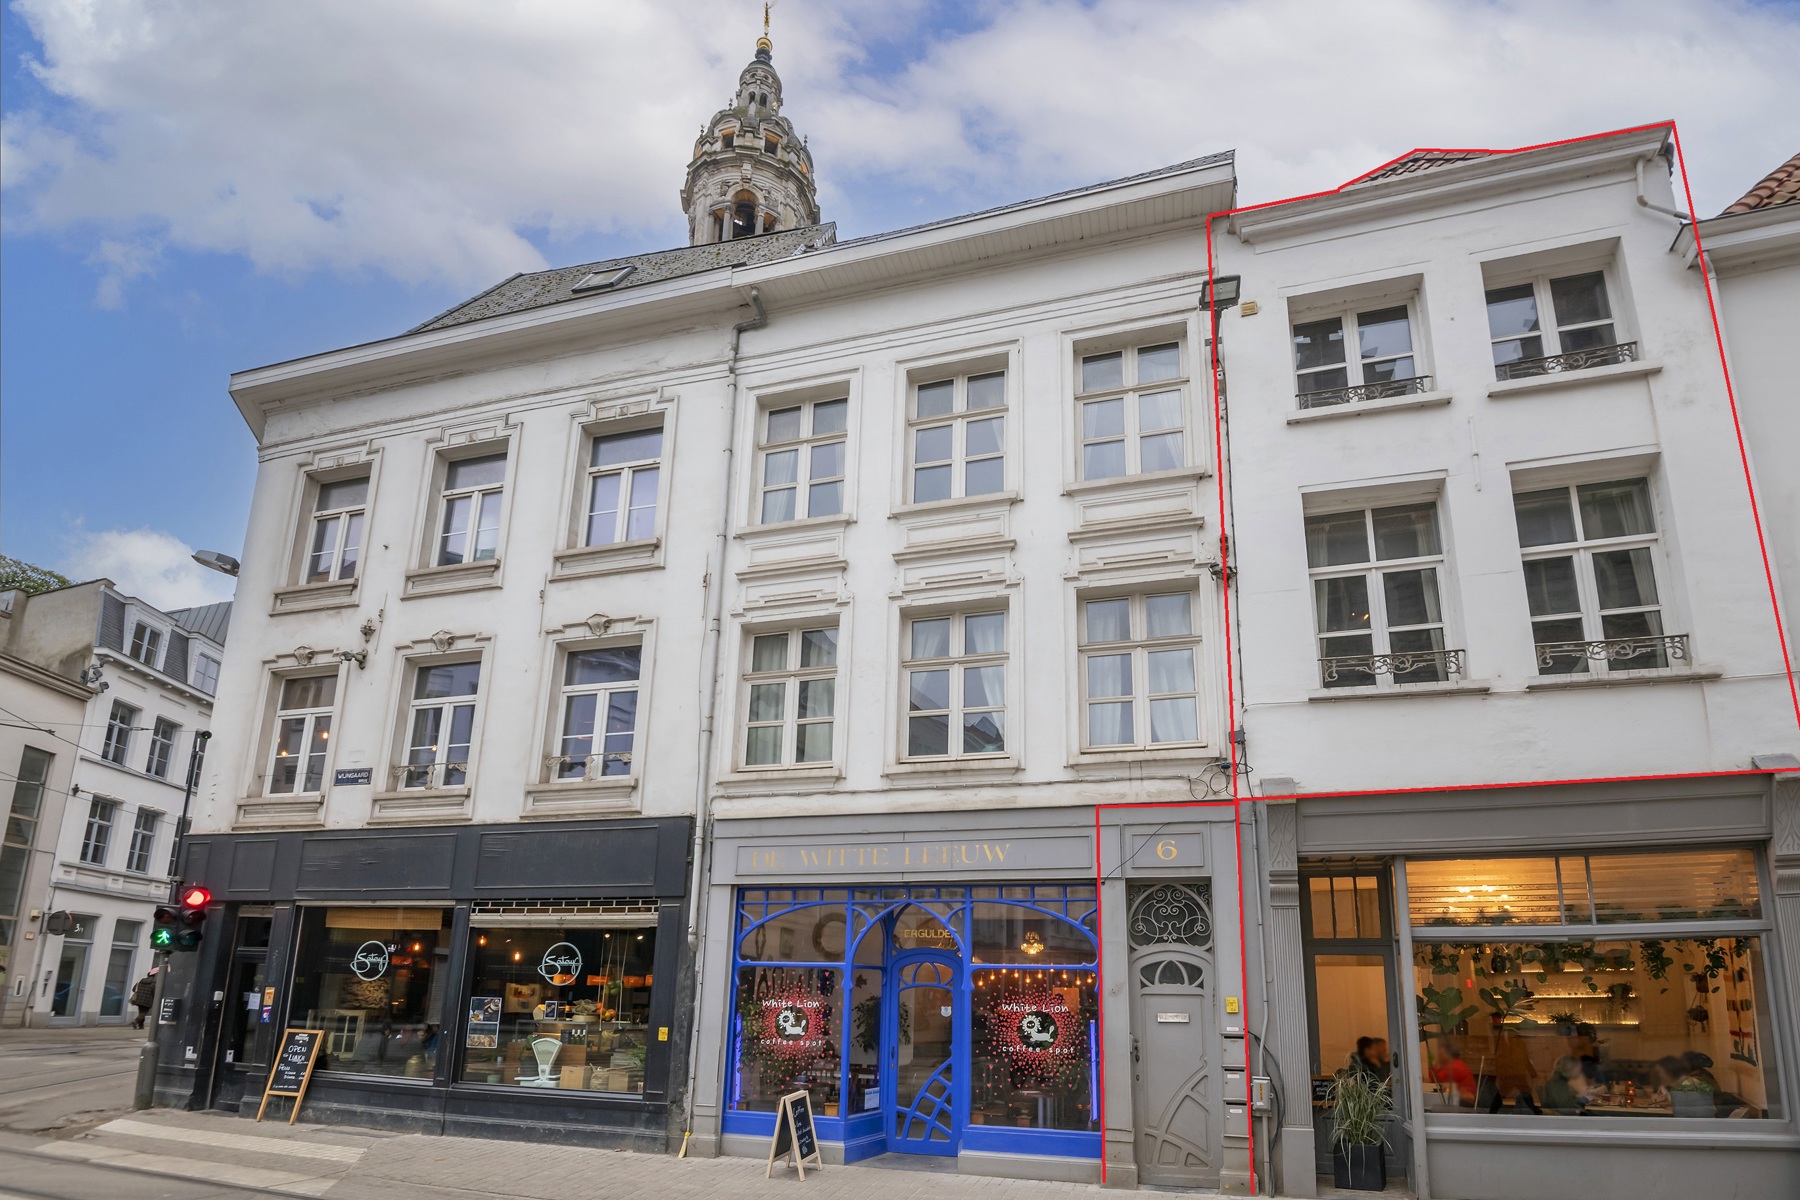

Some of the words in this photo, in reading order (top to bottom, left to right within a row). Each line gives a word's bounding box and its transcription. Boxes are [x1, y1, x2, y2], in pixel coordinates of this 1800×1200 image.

[1156, 839, 1178, 860] 6
[752, 850, 785, 869] DE
[800, 847, 889, 867] WITTE
[904, 843, 1010, 865] LEEUW
[903, 929, 954, 939] ERGULDE
[762, 999, 793, 1008] White
[796, 999, 820, 1008] Lion
[1002, 1003, 1037, 1012] White
[1042, 1004, 1069, 1012] Lion
[760, 1038, 793, 1046] coffee
[1002, 1045, 1040, 1053] coffee
[1048, 1047, 1074, 1055] spot
